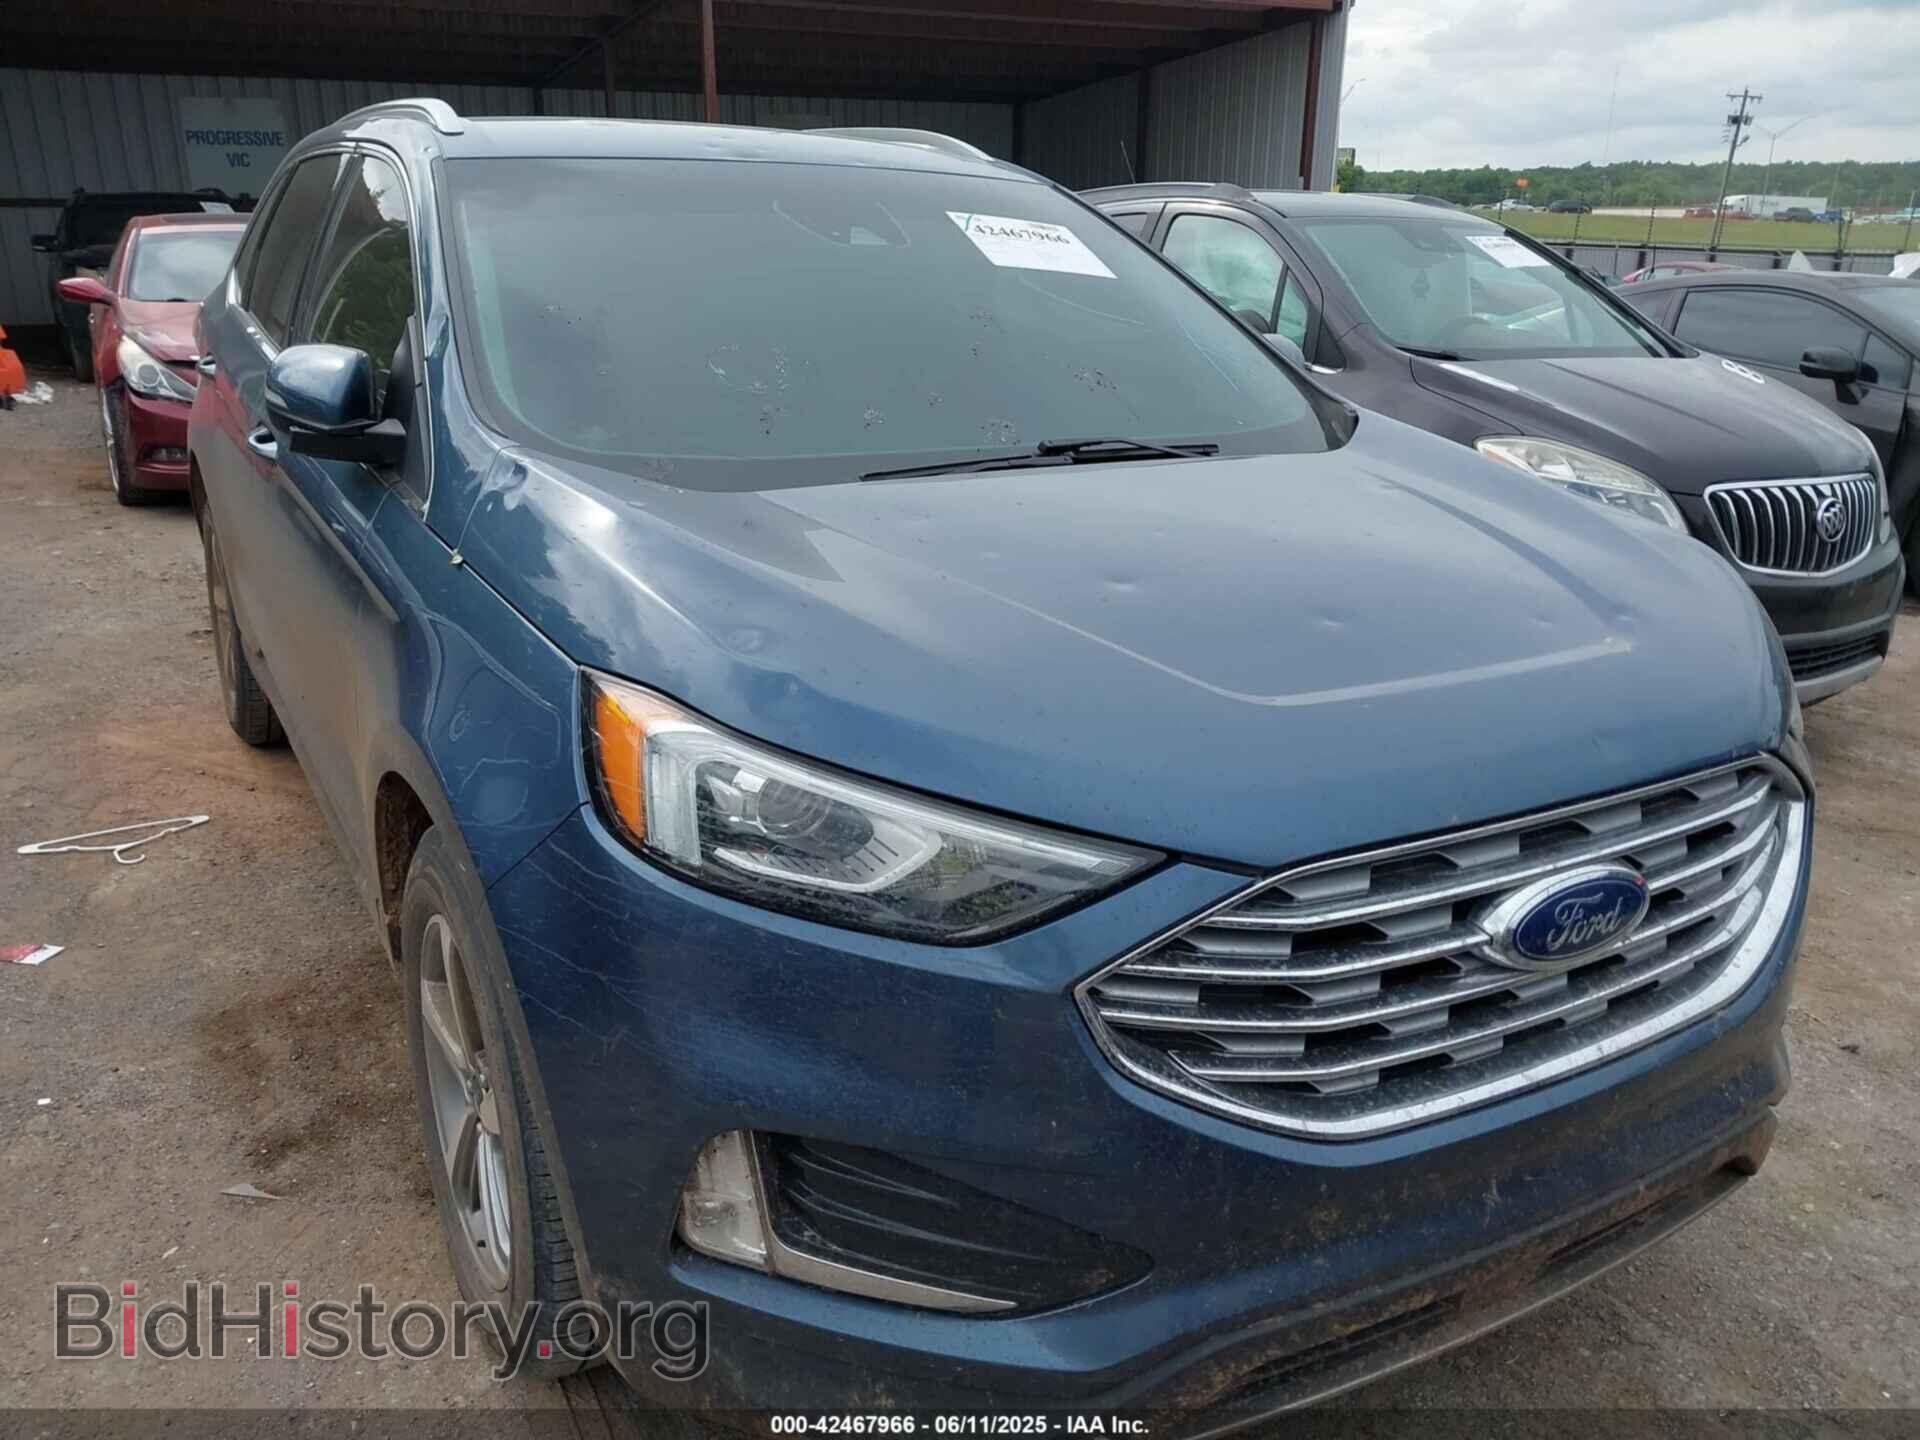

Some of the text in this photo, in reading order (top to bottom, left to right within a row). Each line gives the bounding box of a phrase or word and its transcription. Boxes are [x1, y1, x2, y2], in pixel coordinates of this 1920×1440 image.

[185, 129, 284, 147] PROGRESSIVE
[225, 151, 251, 169] VIC
[973, 223, 1071, 245] 42467966
[1546, 891, 1624, 951] Ford
